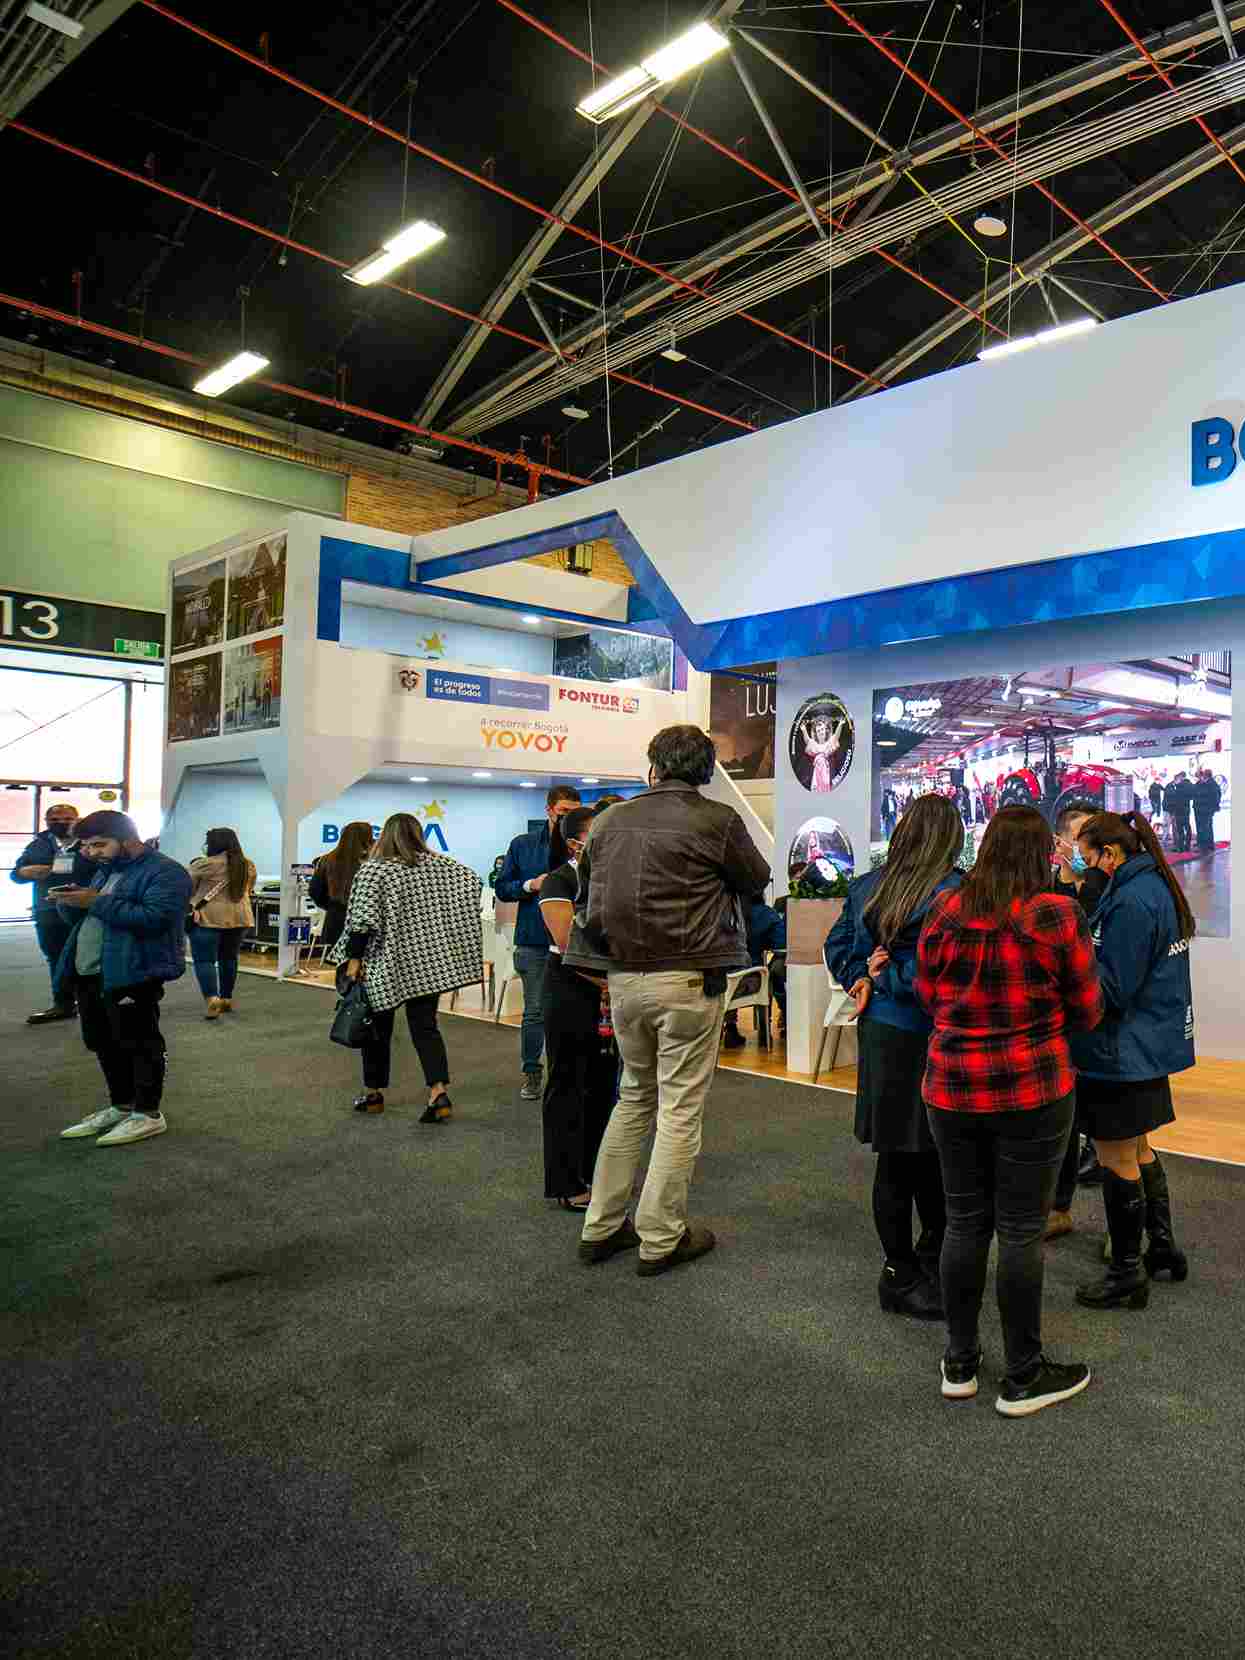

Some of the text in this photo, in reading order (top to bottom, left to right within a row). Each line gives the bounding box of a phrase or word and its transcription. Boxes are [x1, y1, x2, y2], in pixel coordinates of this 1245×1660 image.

[433, 677, 481, 691] El progreso
[559, 688, 619, 707] FONTUR
